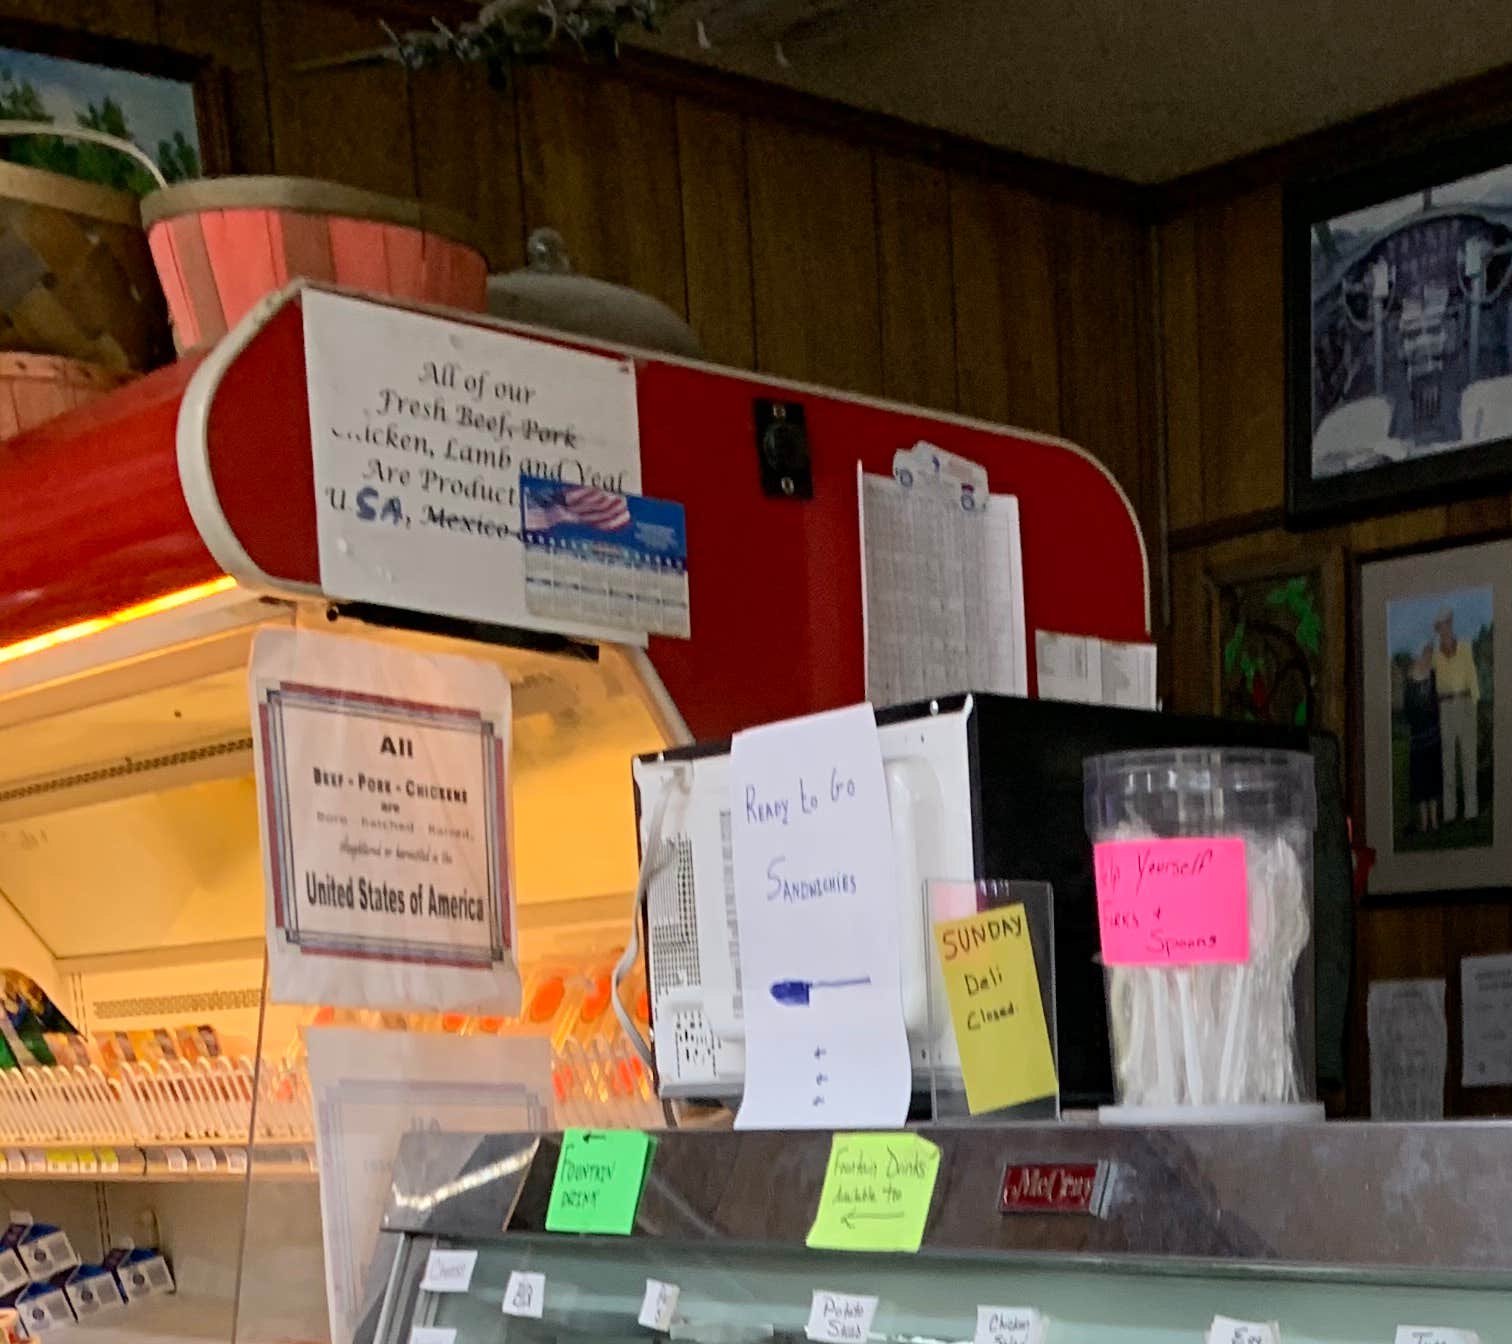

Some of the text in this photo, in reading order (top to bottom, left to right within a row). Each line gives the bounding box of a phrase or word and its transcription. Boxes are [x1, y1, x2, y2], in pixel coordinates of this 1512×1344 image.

[418, 362, 536, 404] All of our
[376, 389, 447, 424] Fresh
[331, 422, 435, 458] icken,
[444, 439, 513, 471] Lamb
[363, 459, 518, 507] Are Product
[380, 735, 413, 758] All
[306, 871, 485, 923] United States of America
[942, 915, 1022, 961] SUNDAY
[963, 964, 1003, 998] Deli
